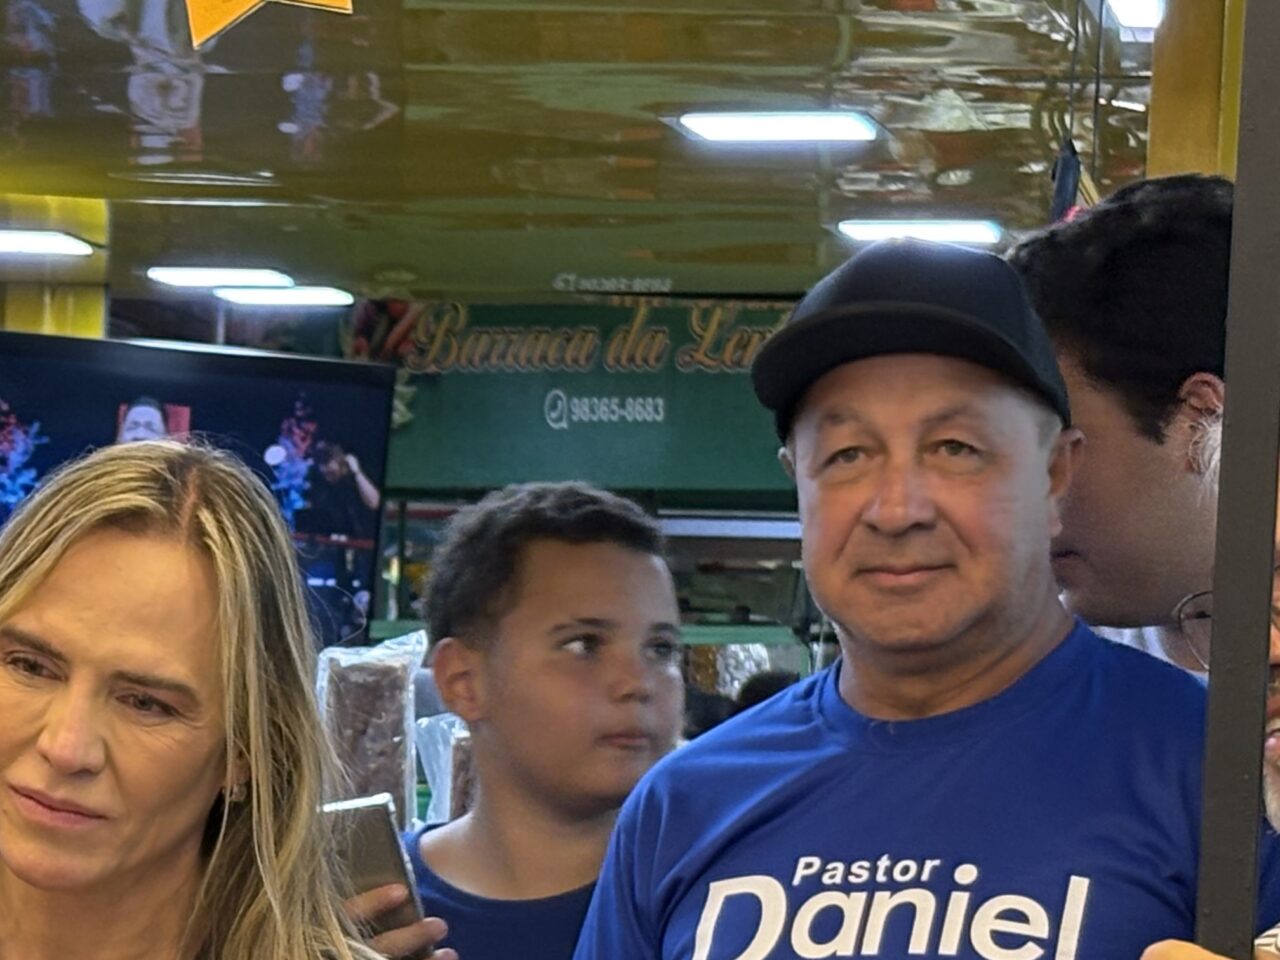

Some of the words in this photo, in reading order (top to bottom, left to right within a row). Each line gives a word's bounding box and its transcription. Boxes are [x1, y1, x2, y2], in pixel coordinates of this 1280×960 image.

[406, 301, 600, 374] Barraca
[604, 297, 670, 373] da
[792, 853, 942, 886] Pastor
